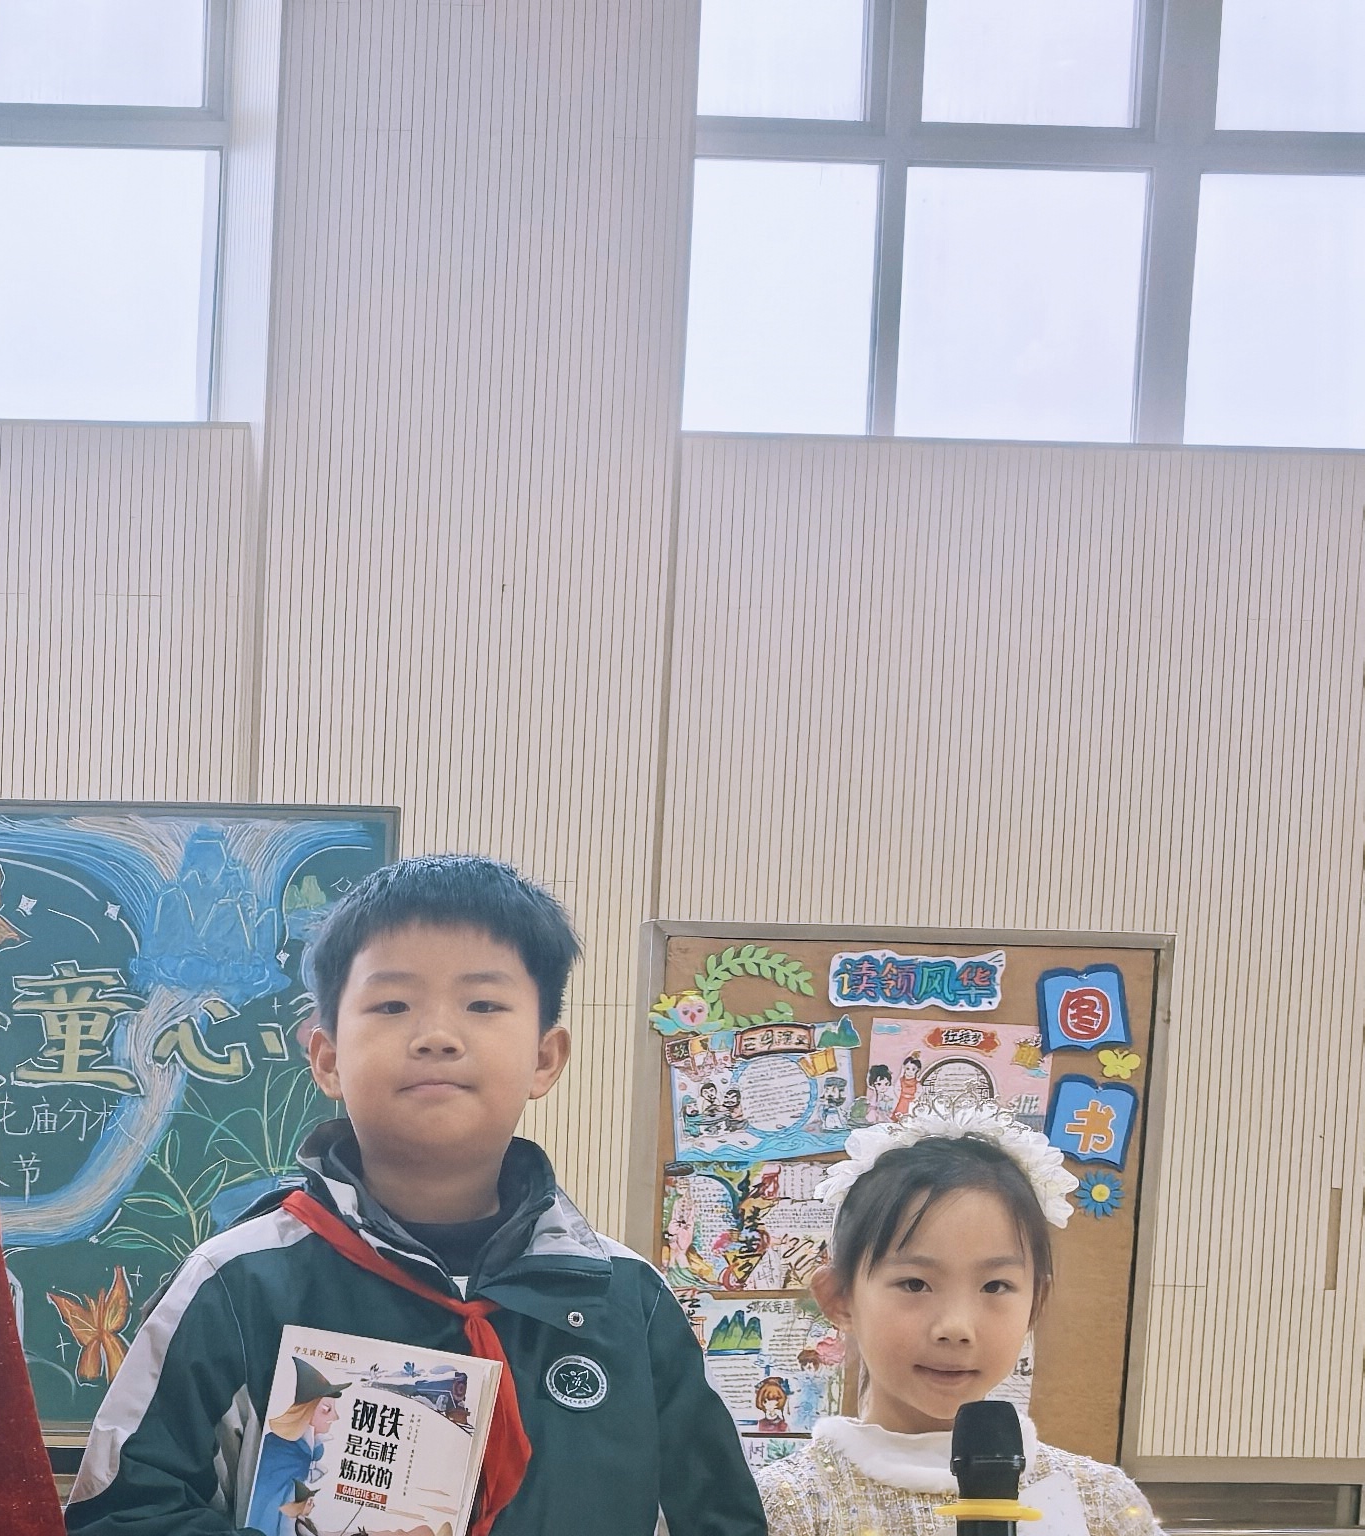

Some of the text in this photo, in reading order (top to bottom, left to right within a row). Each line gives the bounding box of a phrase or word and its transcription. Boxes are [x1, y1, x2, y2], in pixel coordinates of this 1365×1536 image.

[840, 960, 992, 1003] 读领风华
[1058, 987, 1112, 1042] 图
[1066, 1101, 1116, 1153] 书
[350, 1398, 405, 1440] 钢铁
[344, 1433, 398, 1464] 是怎样
[338, 1458, 393, 1490] 炼成的
